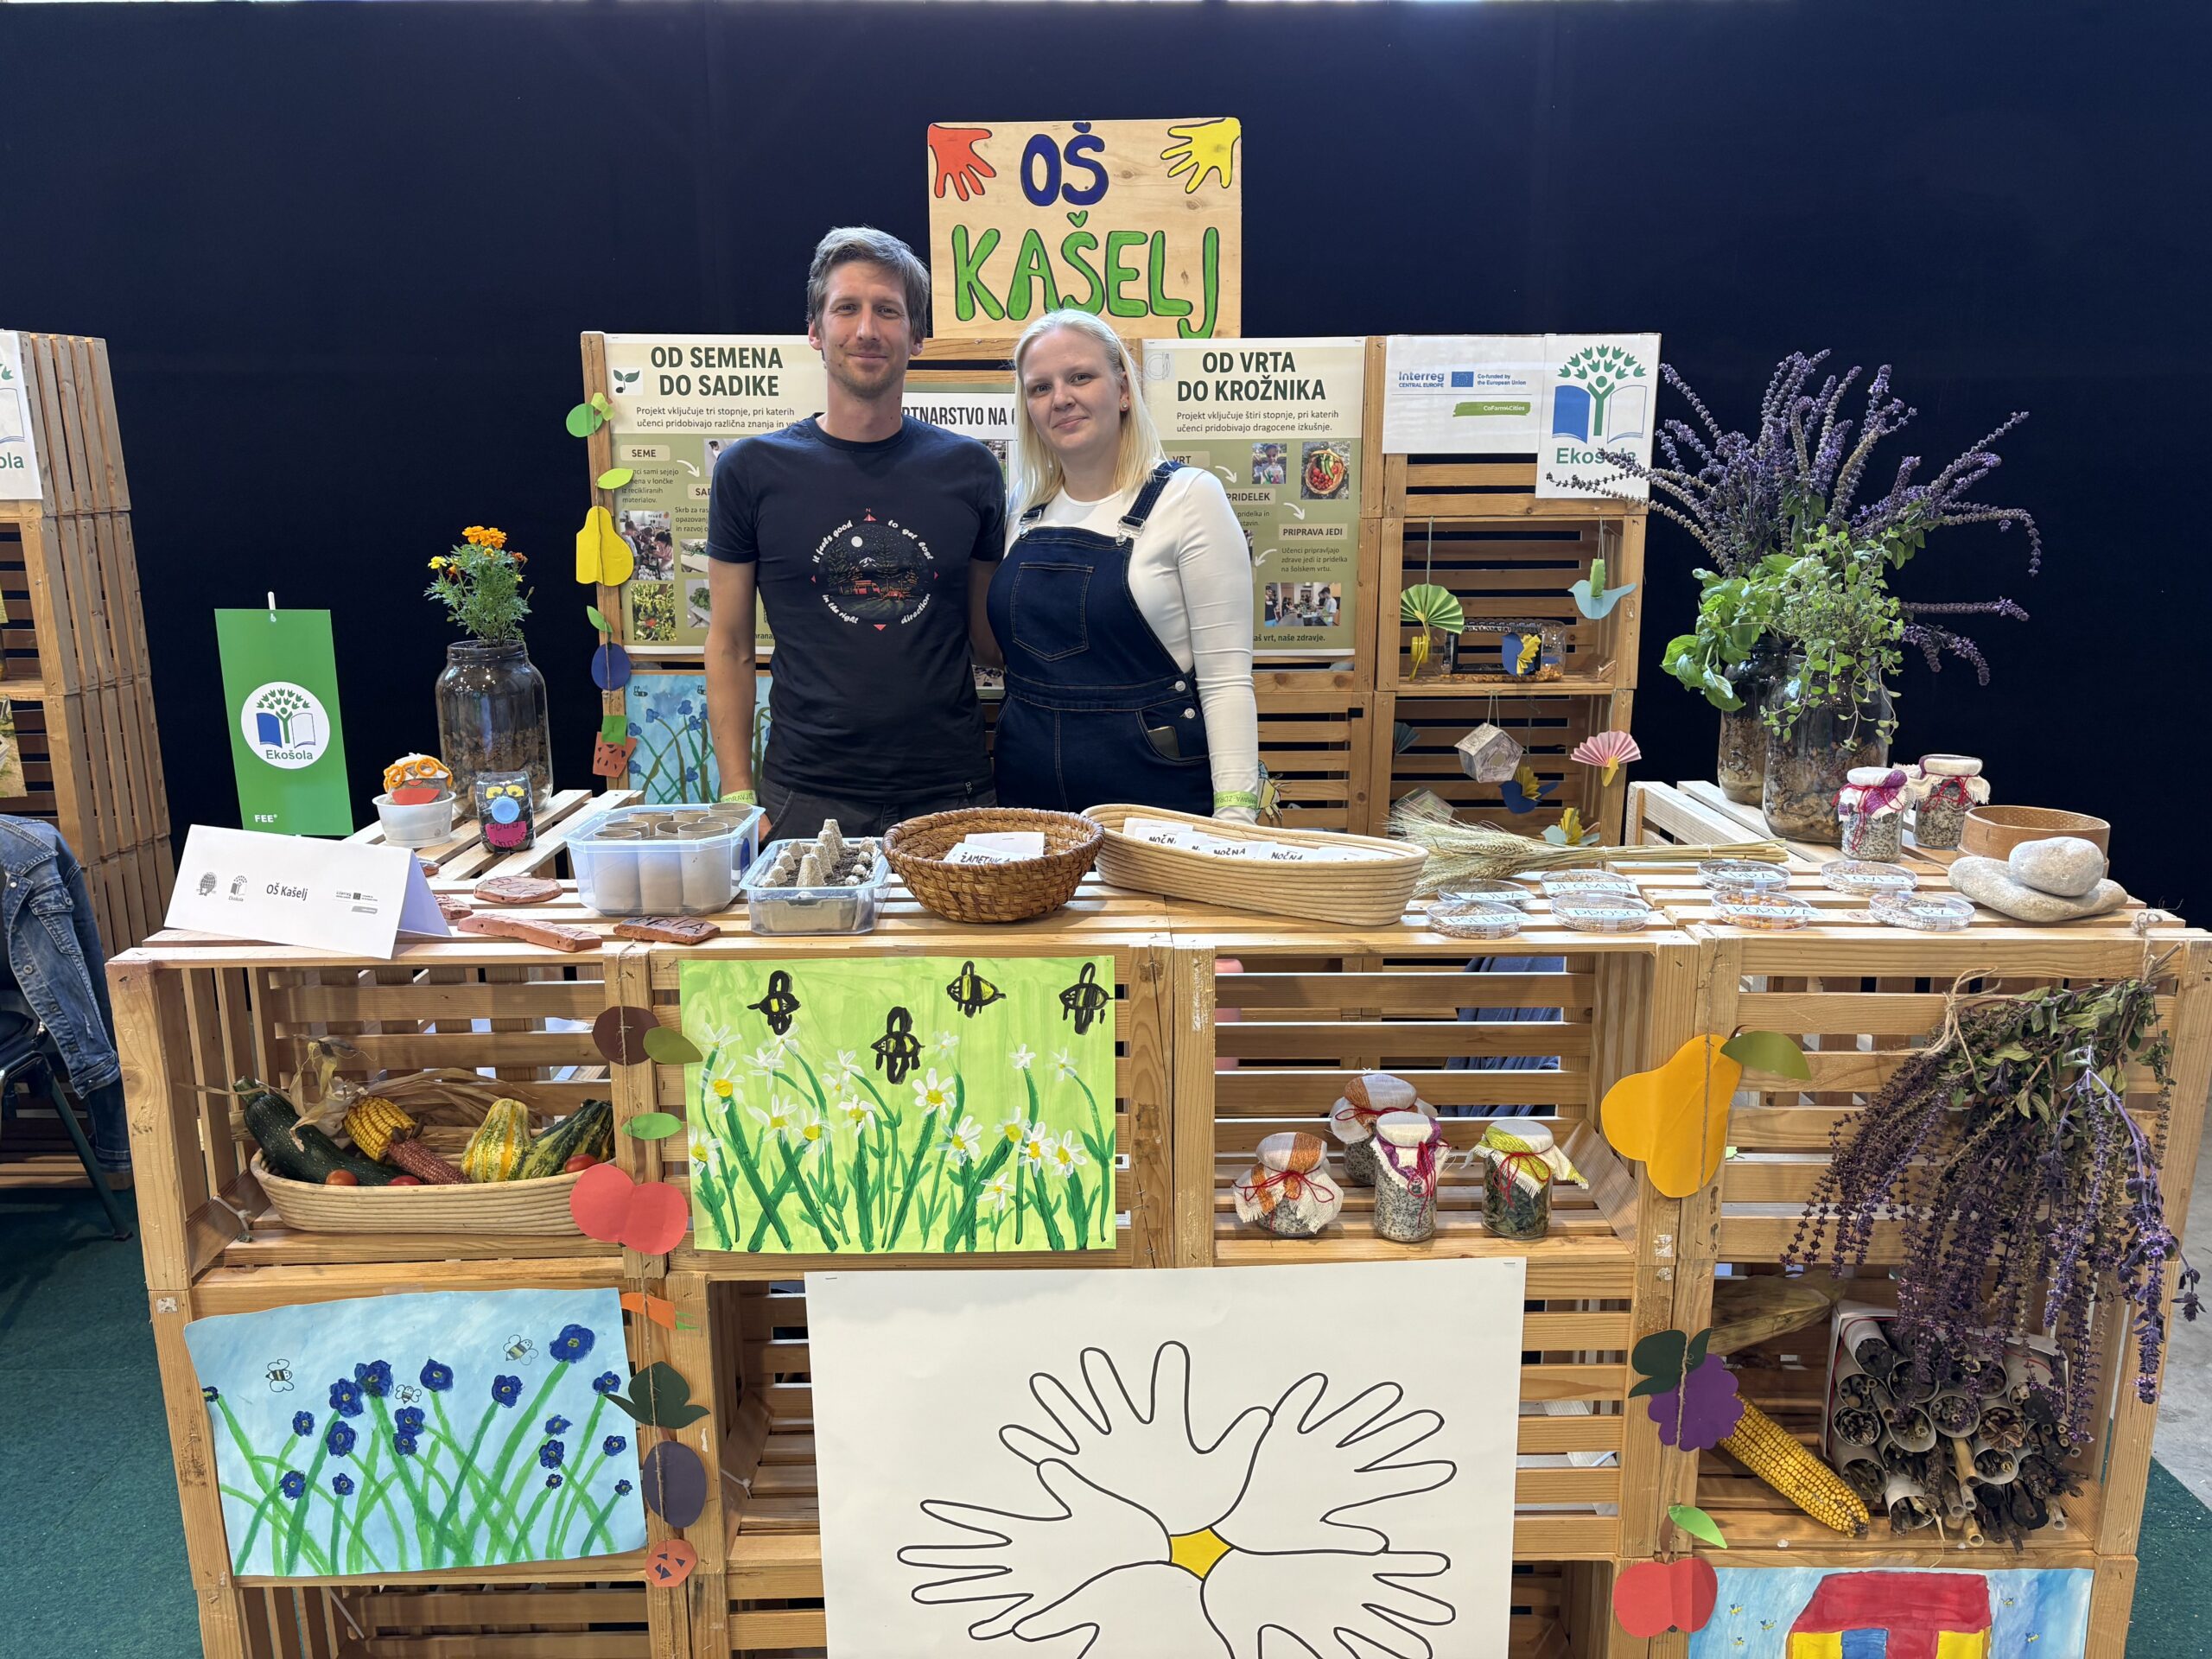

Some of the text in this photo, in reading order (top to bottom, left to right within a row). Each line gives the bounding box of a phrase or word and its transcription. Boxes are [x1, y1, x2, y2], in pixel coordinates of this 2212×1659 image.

[1020, 121, 1109, 207] OŠ
[951, 210, 1220, 339] KAŠELJ
[651, 346, 784, 369] OD SEMENA
[1202, 352, 1296, 373] OD VRTA
[659, 374, 779, 397] DO SADIKE
[1398, 372, 1445, 382] Interreg
[1178, 374, 1326, 402] DO KROŽNIKA
[636, 407, 665, 417] Projekt
[667, 407, 704, 417] vključuje
[717, 408, 751, 418] stopnje,
[753, 408, 764, 417] pri
[766, 407, 795, 416] katerih
[902, 407, 984, 425] TNARSTVO
[988, 407, 1007, 425] NA
[1177, 412, 1205, 421] Projekt
[1207, 411, 1243, 421] vključuje
[1263, 411, 1295, 421] stopnje,
[1297, 410, 1309, 421] pri
[665, 419, 713, 429] pridobivajo
[747, 420, 774, 429] znanja
[1205, 423, 1251, 433] pridobivajo
[1253, 423, 1295, 433] dragocene
[1297, 423, 1332, 432] izkušnje.
[1173, 455, 1192, 464] VRT
[1226, 493, 1271, 501] PRIDELEK
[833, 520, 853, 538] good
[888, 519, 934, 561] to get lost
[828, 602, 840, 613] the
[838, 612, 859, 624] right
[1296, 633, 1325, 642] zdravje.
[265, 749, 314, 760] Ekošola
[1148, 834, 1176, 844] NOČN
[266, 882, 308, 901] OŠ Kašelj
